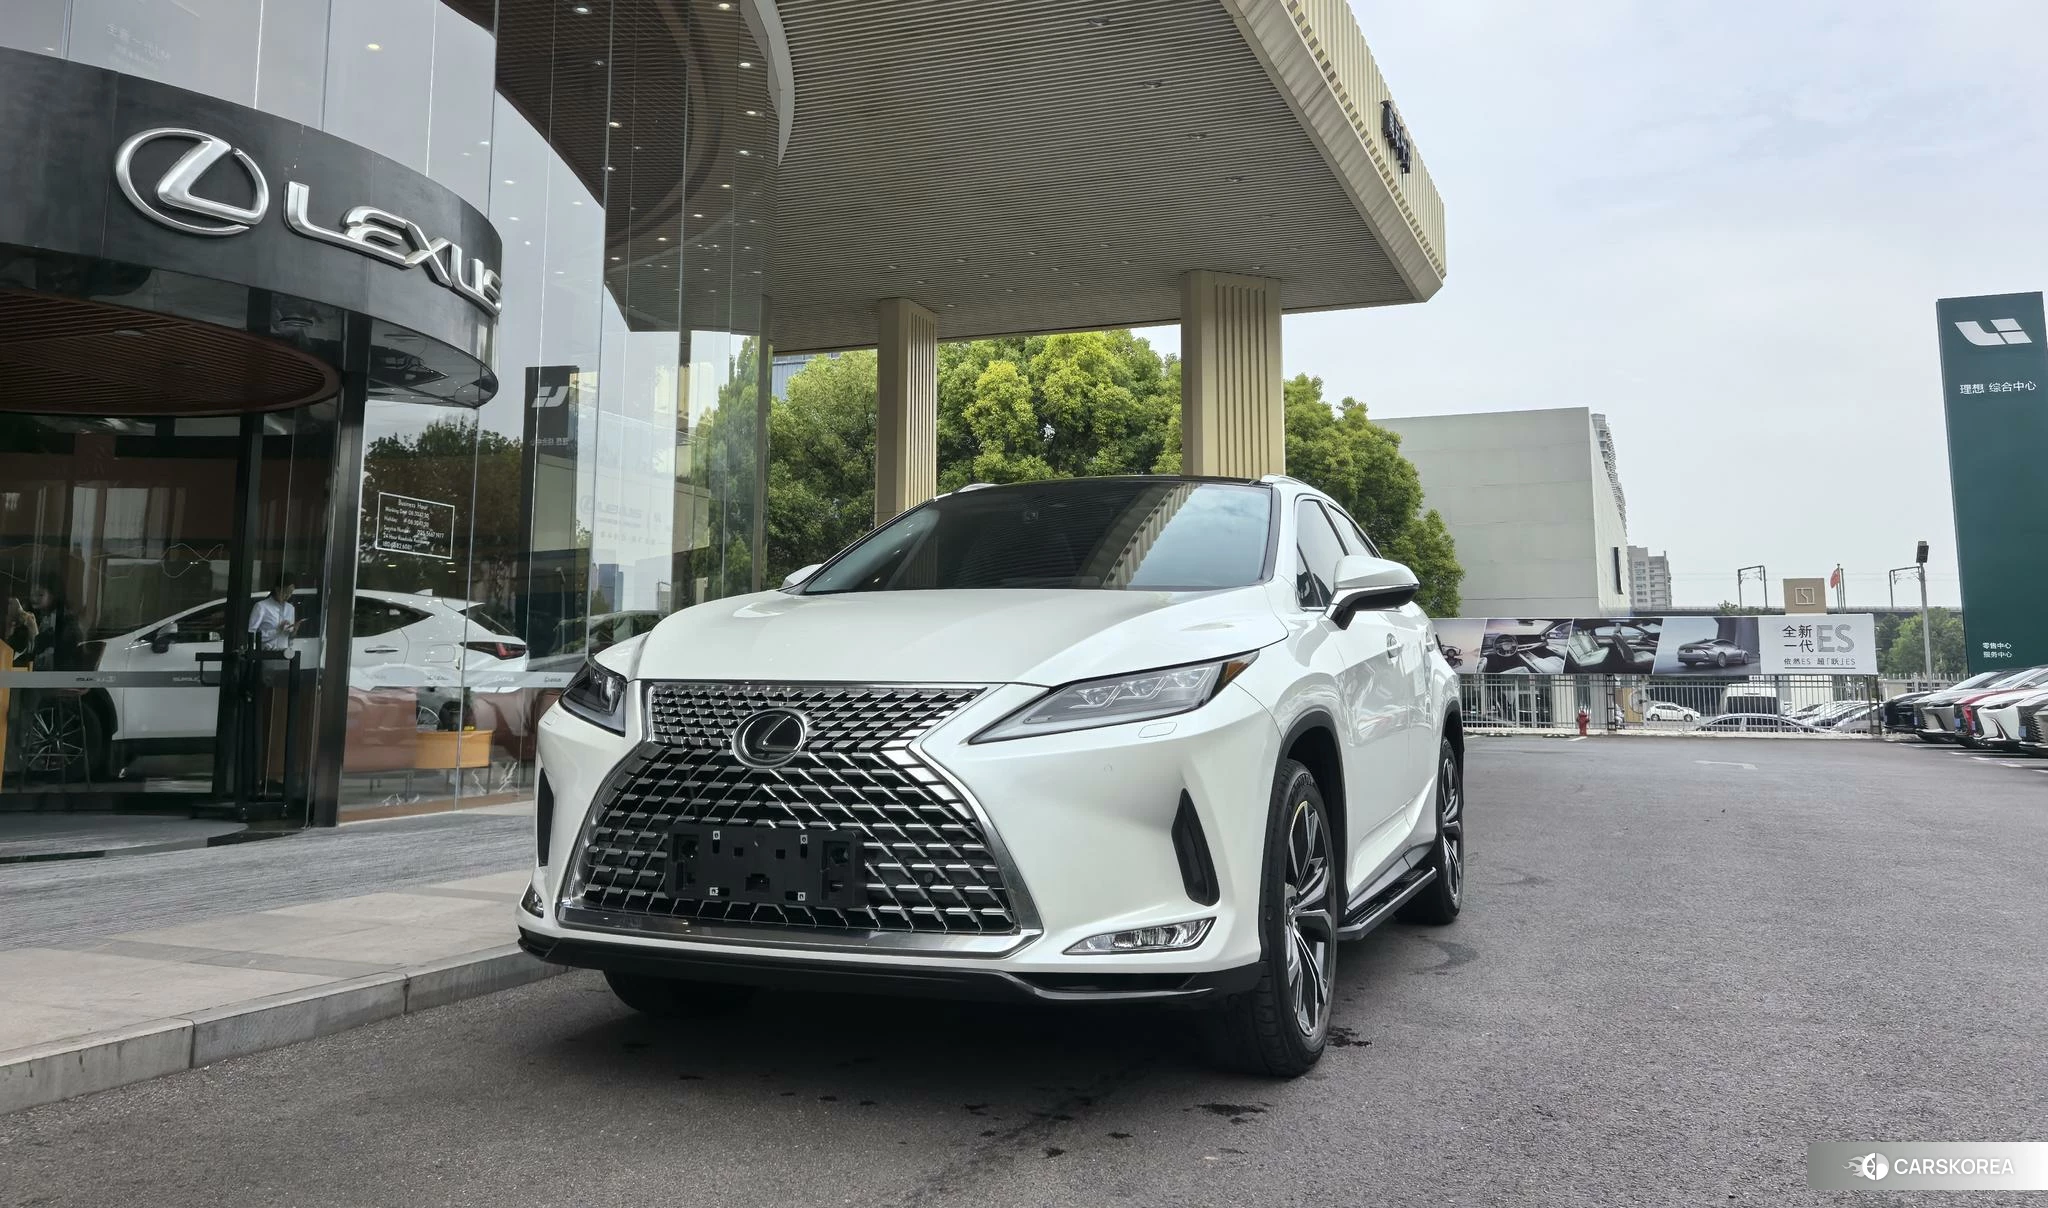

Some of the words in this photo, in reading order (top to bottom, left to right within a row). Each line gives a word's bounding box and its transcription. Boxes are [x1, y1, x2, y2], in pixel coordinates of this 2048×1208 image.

[284, 181, 502, 317] LEXUS
[1959, 383, 1985, 395] 理想
[1988, 380, 2037, 393] 综合中心
[1782, 624, 1813, 639] 全新
[1816, 624, 1855, 653] ES
[1783, 639, 1814, 653] 一代
